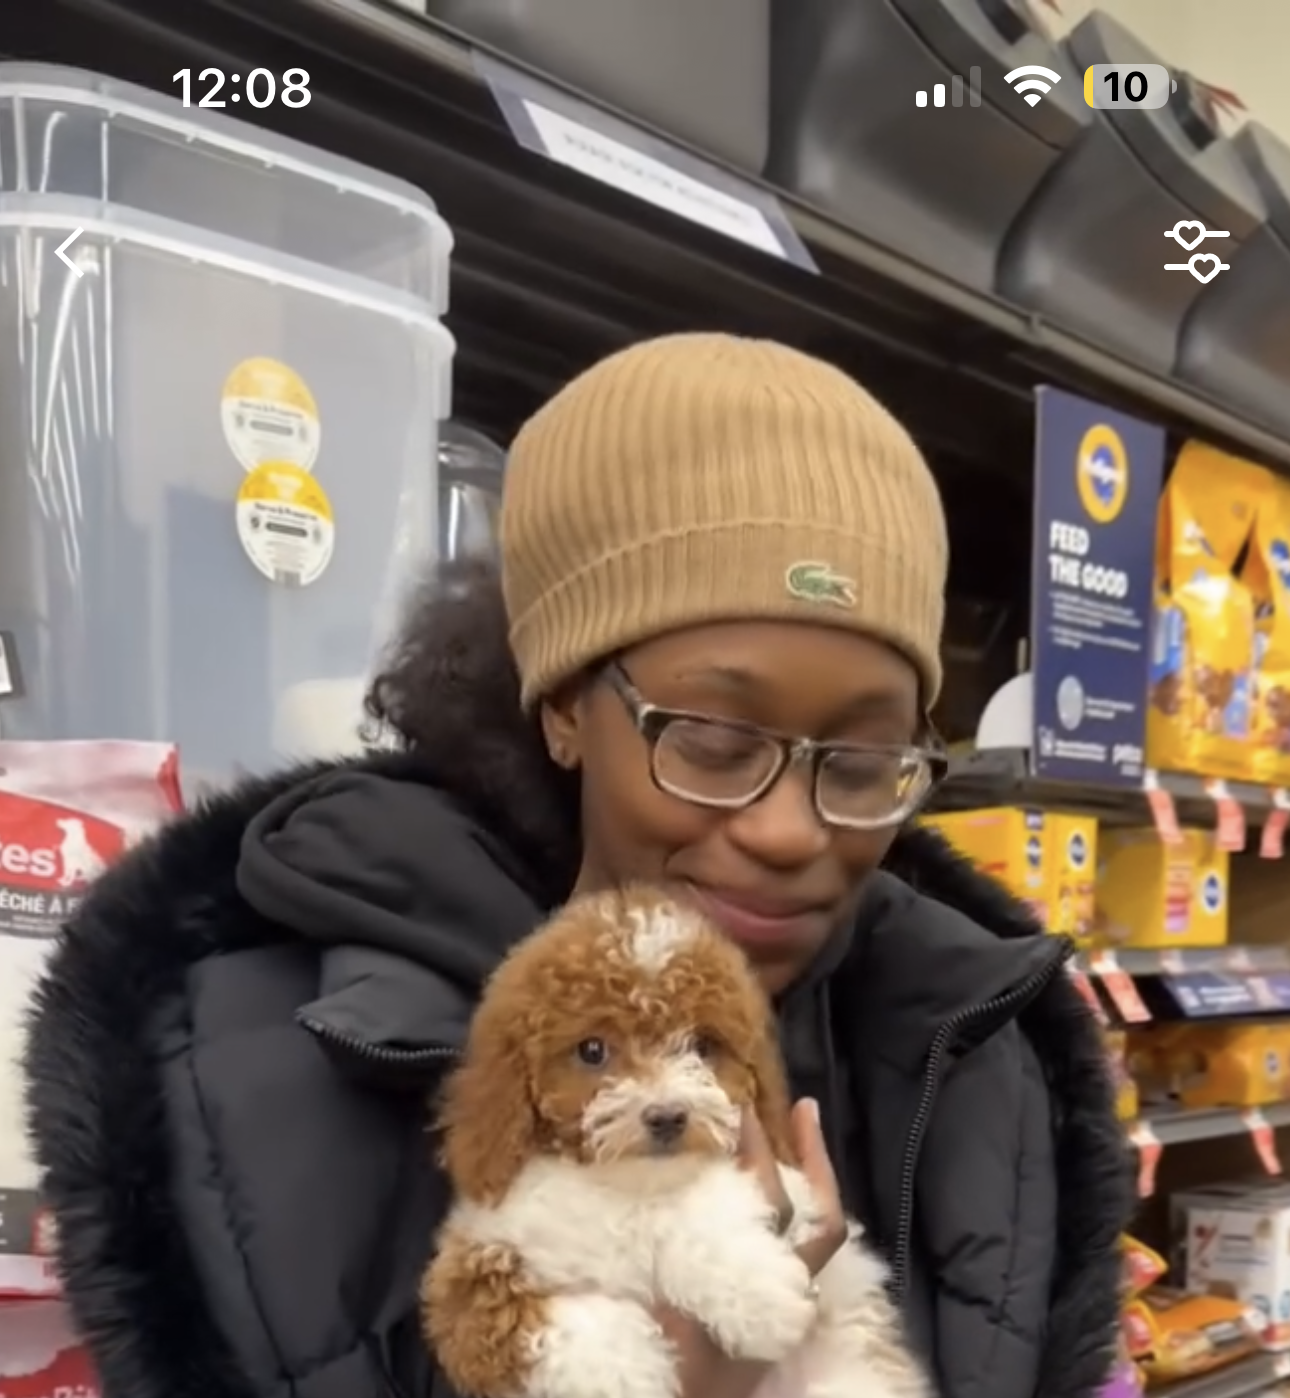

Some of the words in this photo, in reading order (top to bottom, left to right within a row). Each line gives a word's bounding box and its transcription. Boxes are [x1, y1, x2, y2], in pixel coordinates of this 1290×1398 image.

[1050, 520, 1090, 556] FEED
[1049, 554, 1080, 588] THE
[1082, 562, 1128, 598] GOOD
